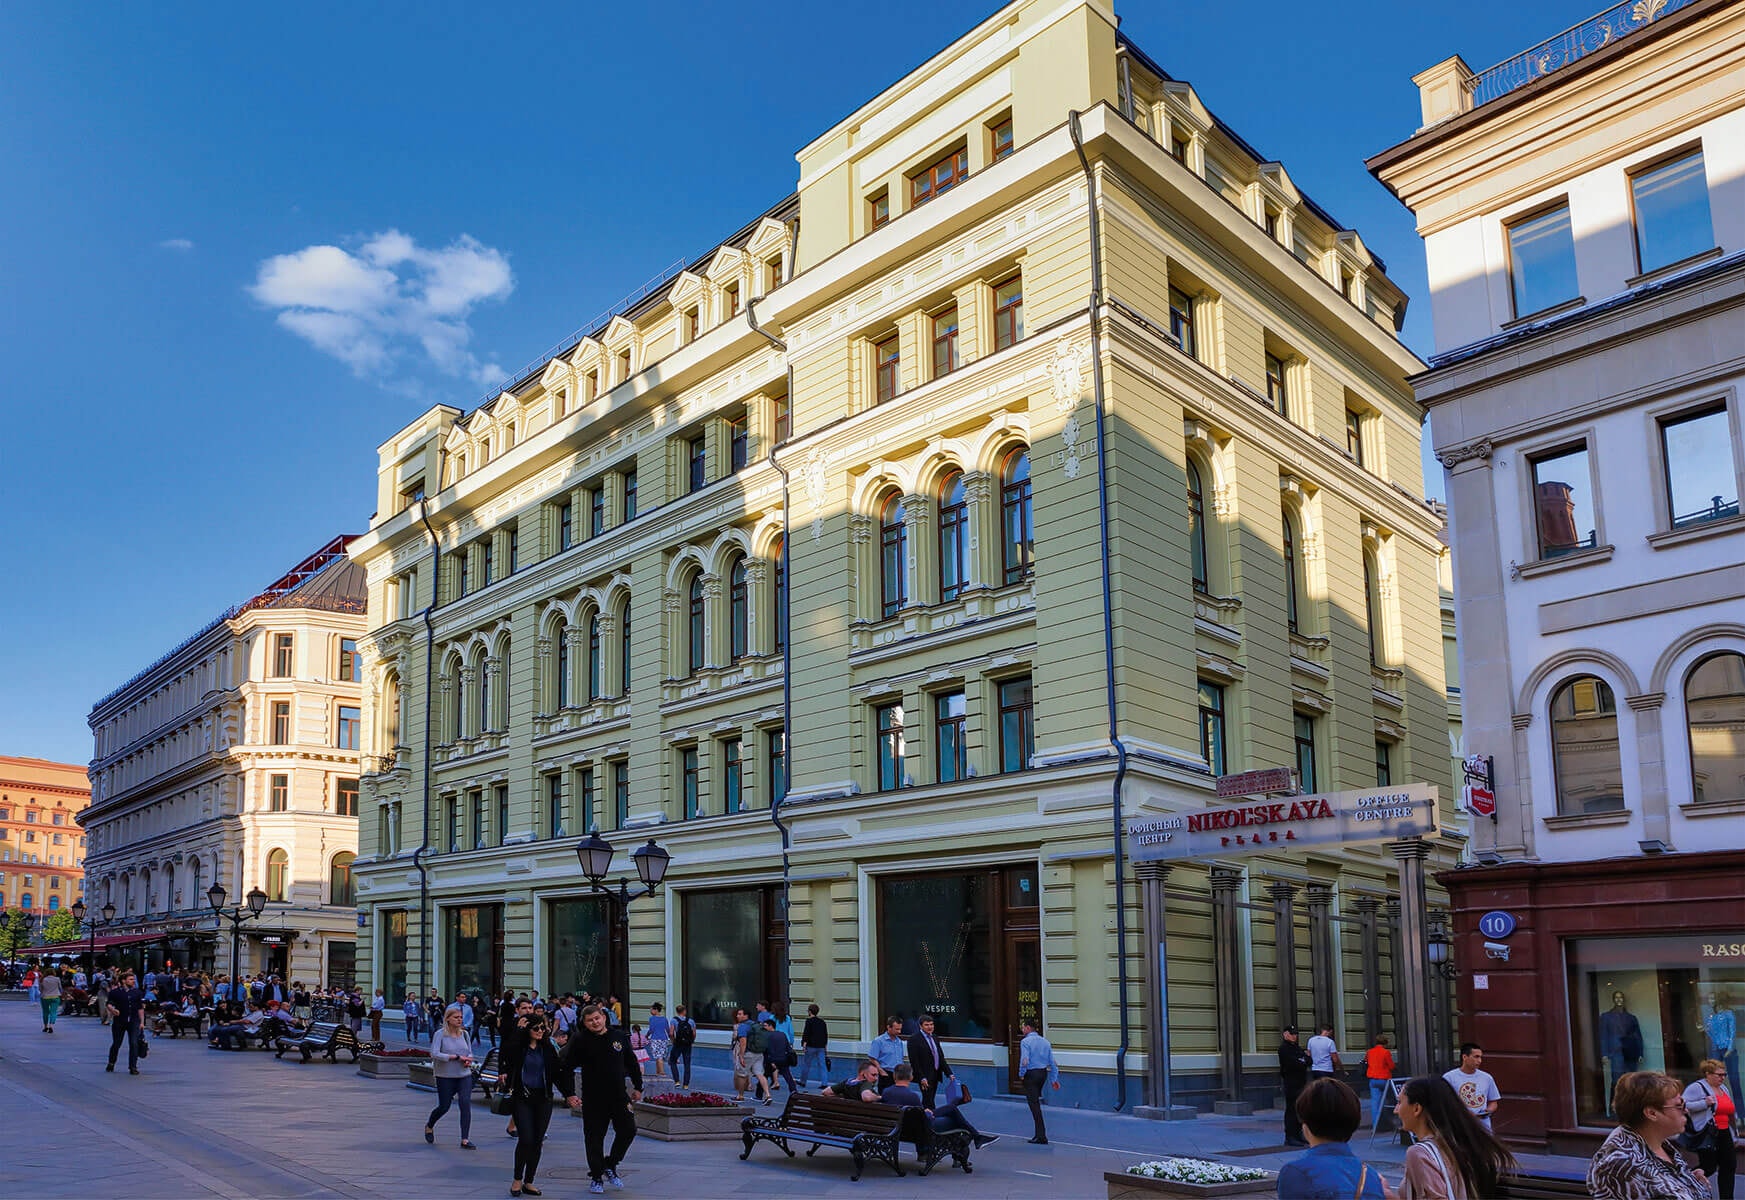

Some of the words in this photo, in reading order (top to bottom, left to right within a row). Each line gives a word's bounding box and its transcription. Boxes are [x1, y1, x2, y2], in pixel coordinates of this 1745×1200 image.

[1356, 792, 1409, 808] OFFICE
[1354, 806, 1413, 822] CENTRE
[1128, 817, 1181, 835] ОФИСНЫЙ
[1138, 832, 1172, 846] ЦЕНТР
[1220, 829, 1297, 847] PLAZA
[1486, 917, 1505, 933] 10
[925, 1005, 956, 1013] VESPER
